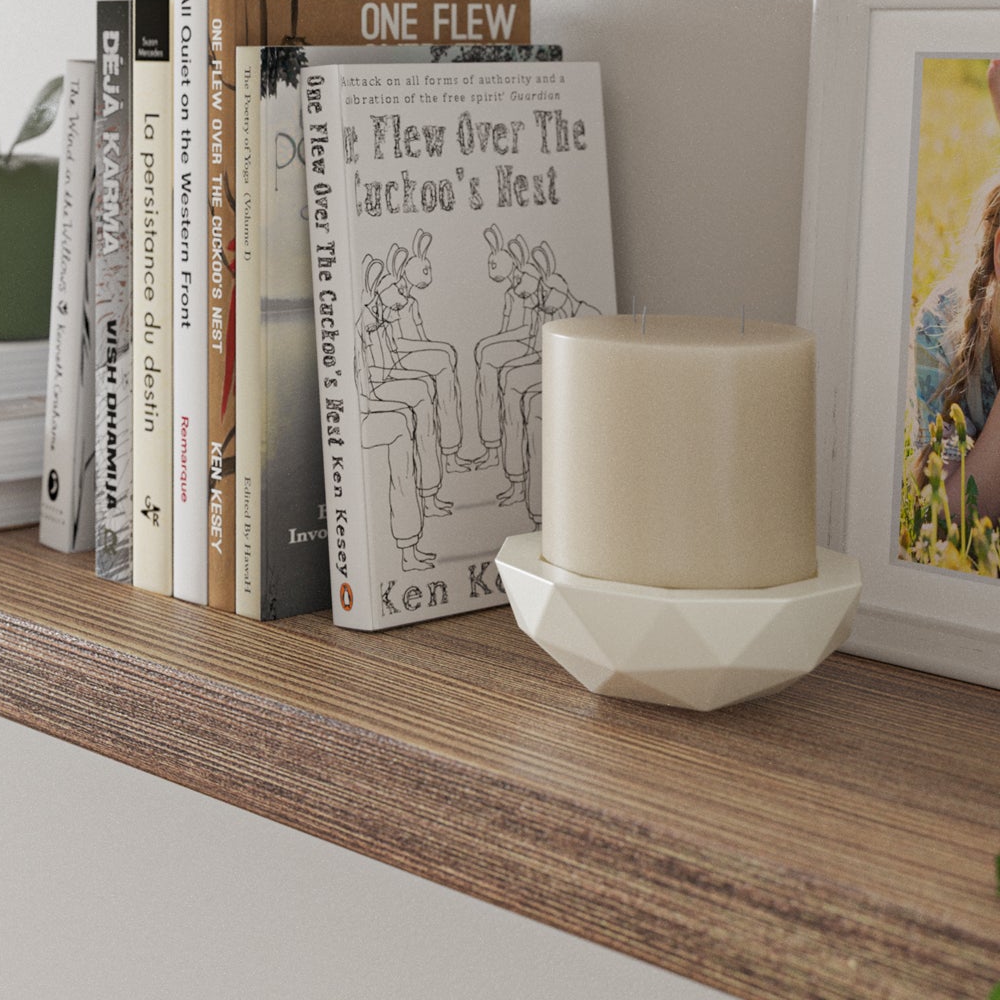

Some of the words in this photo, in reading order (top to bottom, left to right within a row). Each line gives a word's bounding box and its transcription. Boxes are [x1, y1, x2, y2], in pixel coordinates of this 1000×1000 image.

[211, 18, 223, 51] ONE
[361, 2, 418, 41] ONE
[433, 2, 517, 41] FLEW
[180, 25, 192, 87] Quiet
[243, 65, 251, 90] The
[211, 60, 223, 110] FLEW
[307, 74, 325, 114] One
[386, 77, 401, 87] on
[405, 75, 420, 86] all
[424, 74, 459, 86] forms
[462, 74, 475, 85] of
[478, 73, 532, 86] authority
[535, 73, 556, 84] and
[559, 75, 566, 84] a
[404, 92, 416, 104] of
[419, 92, 438, 103] the
[442, 91, 466, 103] free
[470, 91, 505, 105] spirit'
[510, 90, 561, 101] Guardian
[143, 113, 160, 140] La
[180, 93, 189, 121] on
[242, 94, 251, 131] Poetry
[180, 129, 192, 164] the
[211, 119, 223, 165] OVER
[243, 136, 251, 151] of
[310, 121, 329, 176] Flew
[370, 113, 447, 160] Flew
[456, 110, 526, 156] Over
[533, 109, 588, 154] The
[211, 175, 223, 208] THE
[242, 154, 252, 184] Yoga
[495, 164, 560, 208] Nest
[102, 131, 120, 256] KARMA
[313, 182, 333, 234] Over
[140, 152, 159, 302] persistance
[180, 172, 192, 262] Western
[243, 192, 252, 247] (Volume
[211, 215, 223, 300] CUCKOO'S
[316, 239, 336, 282] The
[180, 271, 192, 329] Front
[143, 311, 161, 345] du
[211, 306, 223, 354] NEST
[319, 289, 342, 389] Cuckoo's
[106, 319, 118, 385] VISH
[143, 355, 161, 433] destin
[325, 398, 345, 448] Nest
[106, 392, 118, 511] DHAMIJA
[180, 415, 190, 503] Remarque
[211, 441, 223, 481] KEN
[243, 476, 251, 519] Edited
[331, 455, 345, 499] Ken
[211, 488, 223, 555] KESEY
[242, 523, 251, 539] By
[334, 508, 348, 578] Kesey
[380, 580, 449, 617] Ken
